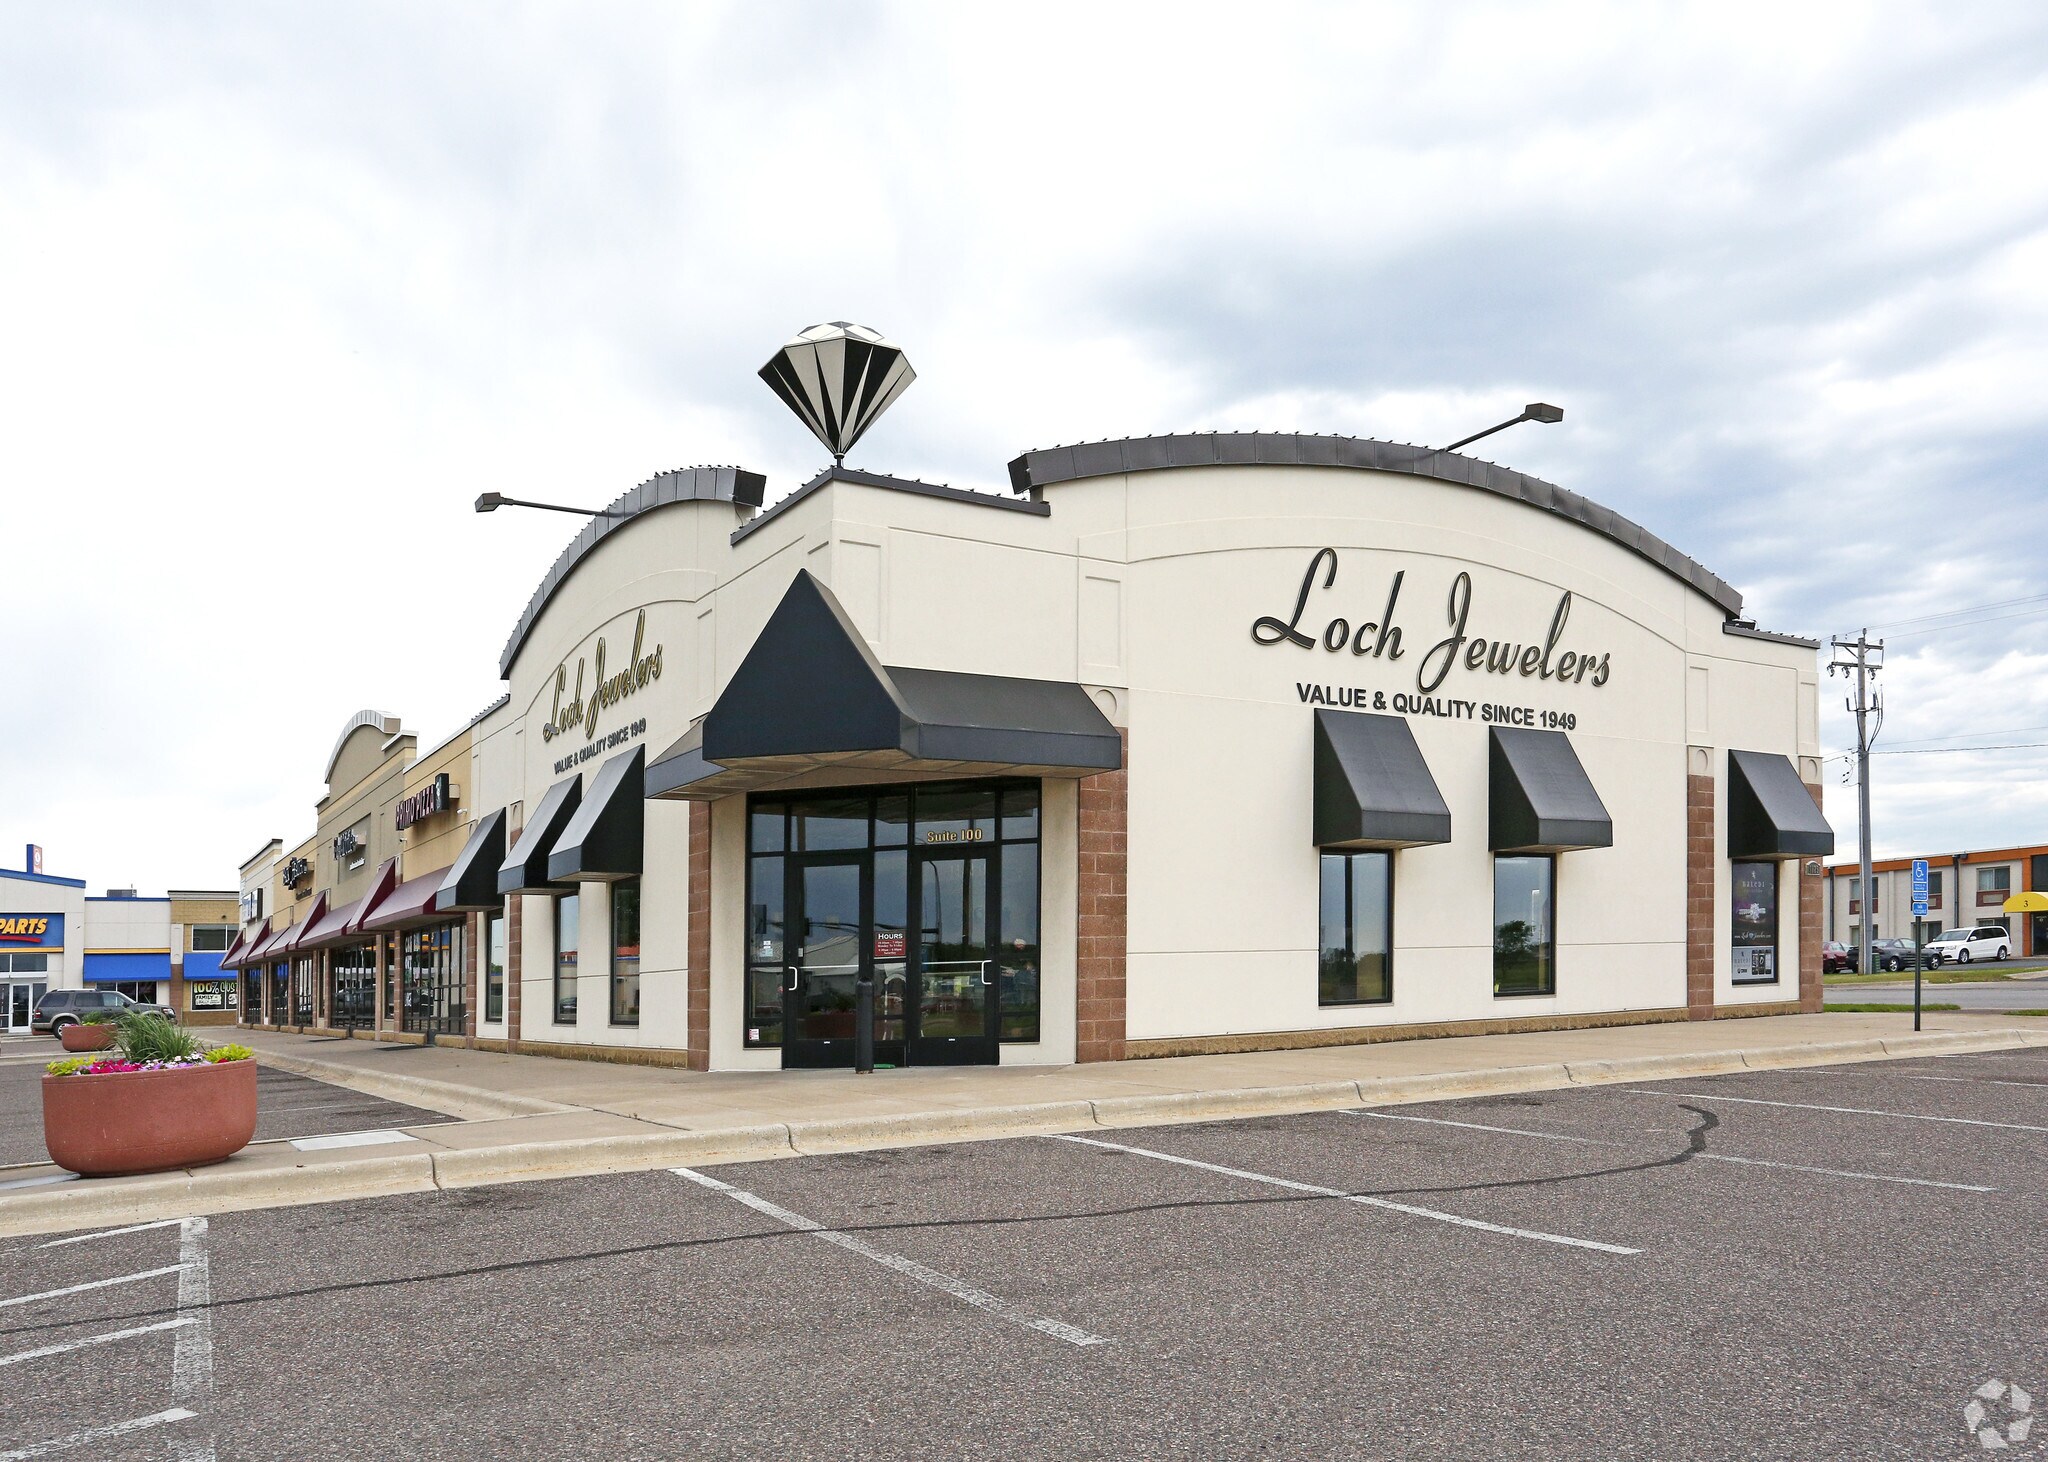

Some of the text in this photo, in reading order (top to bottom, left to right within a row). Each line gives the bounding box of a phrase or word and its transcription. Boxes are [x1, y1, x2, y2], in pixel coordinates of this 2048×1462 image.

[1250, 547, 1611, 694] Loch Jewelers
[543, 609, 663, 742] Loch Jewelers
[1297, 683, 1577, 730] VALUE & QUALITY SINCE 1949
[554, 717, 647, 775] VALUE & QUALITY SINCE 1949
[416, 784, 435, 820] PIZZA
[927, 828, 983, 843] Suite 100
[0, 918, 48, 934] PARTS
[193, 982, 220, 994] 100%
